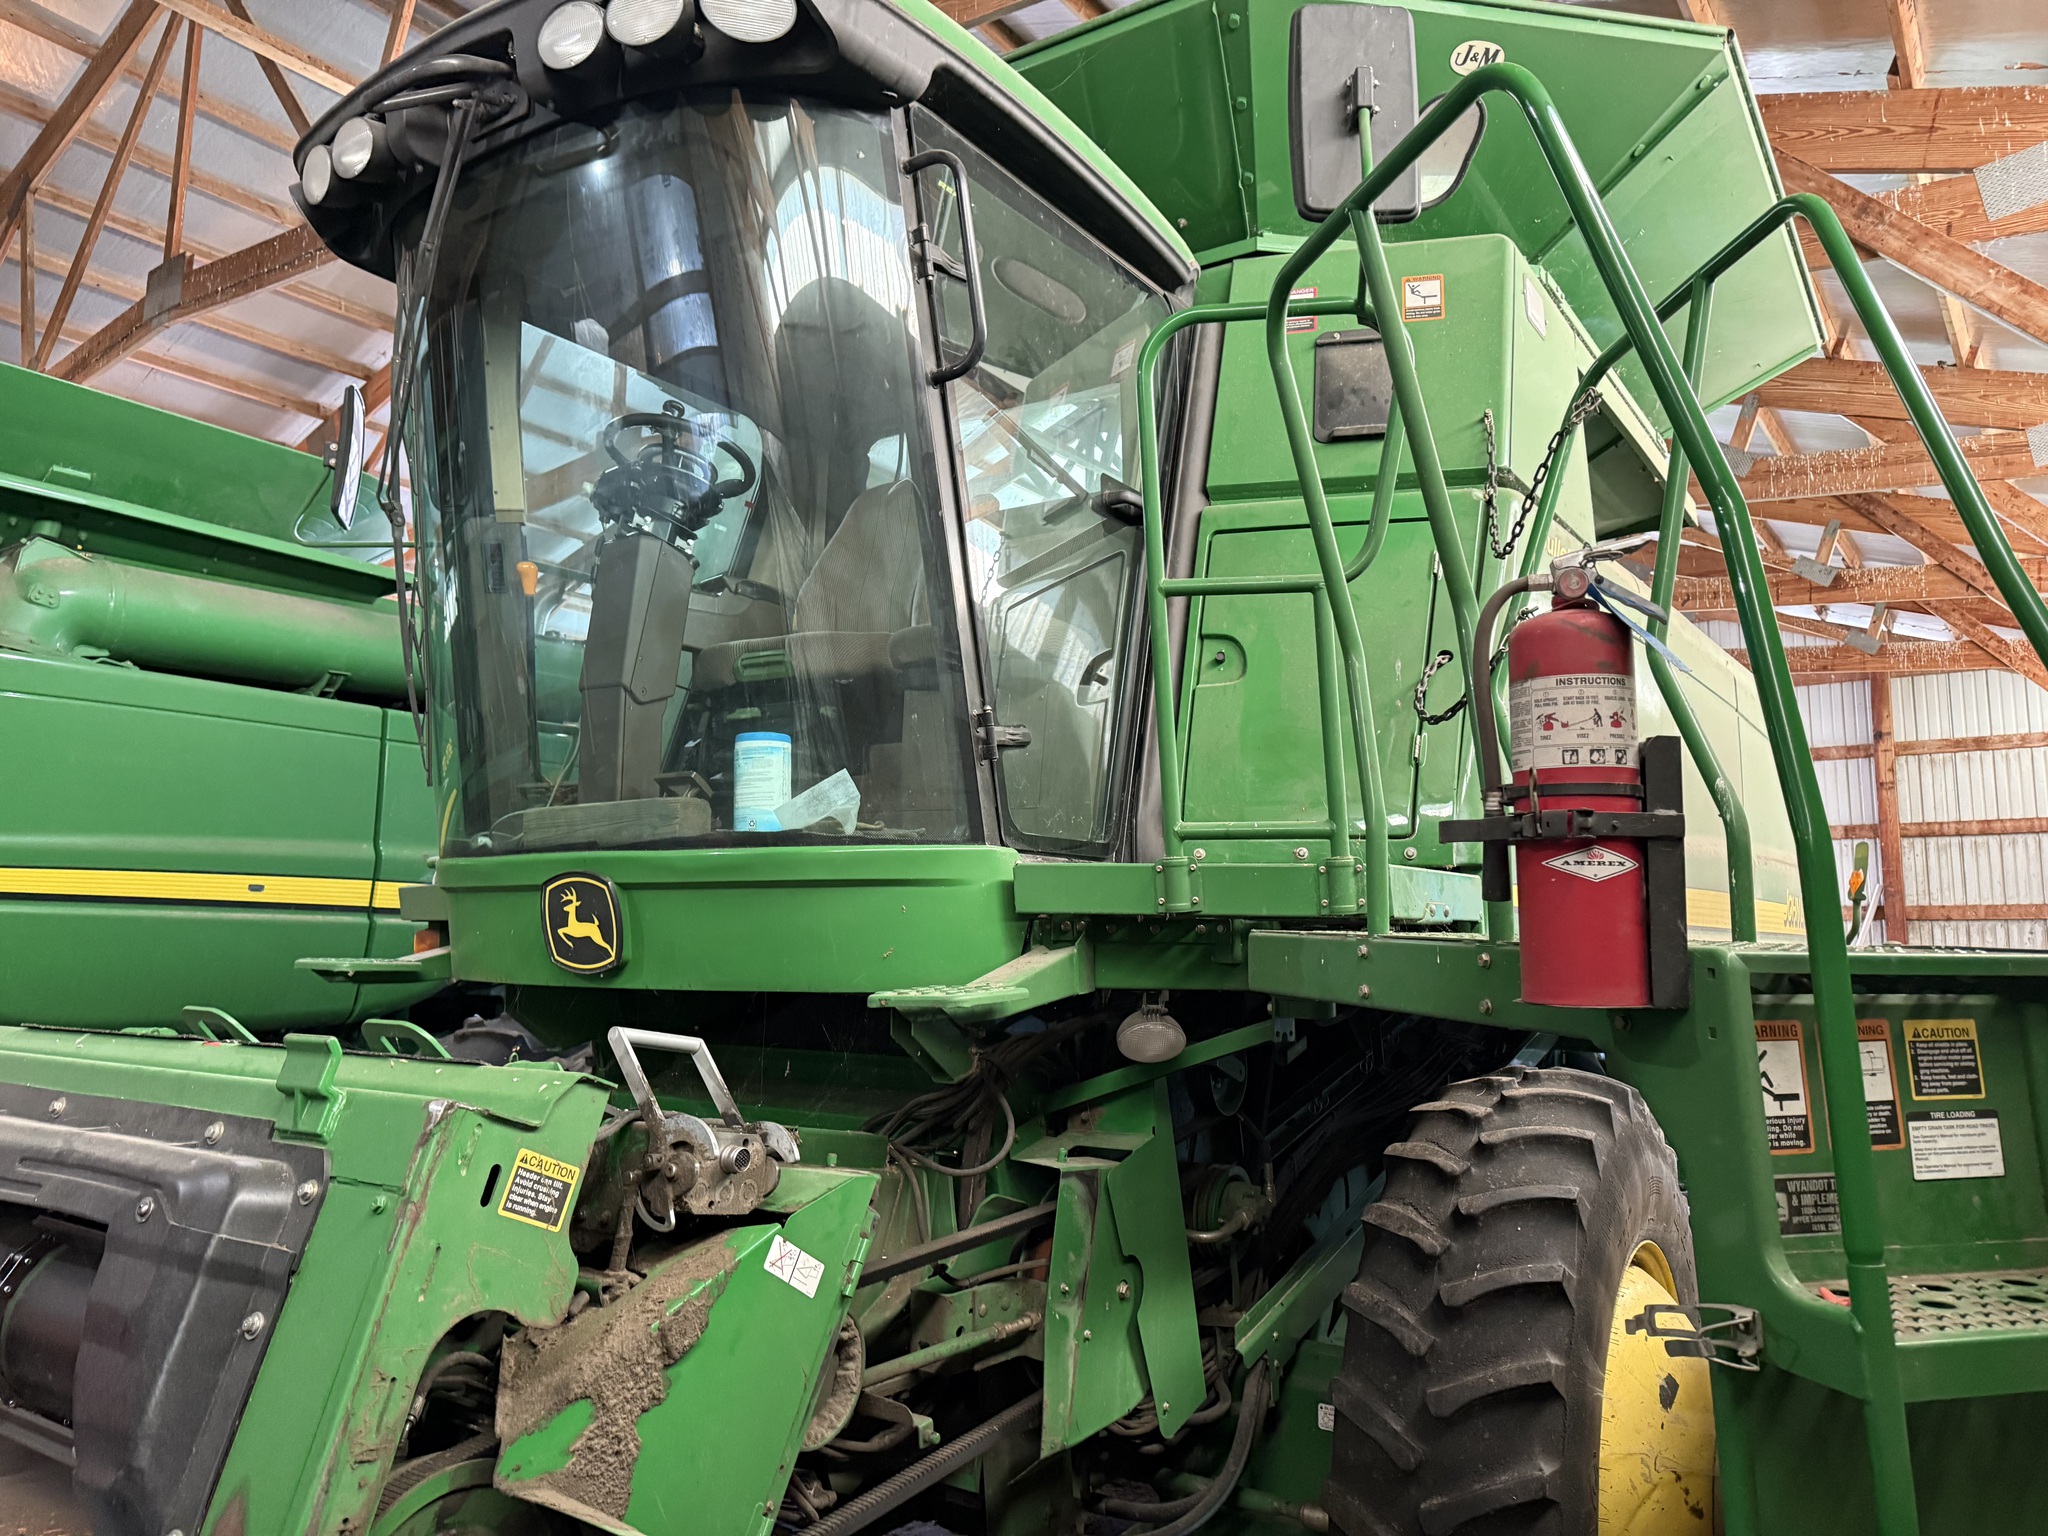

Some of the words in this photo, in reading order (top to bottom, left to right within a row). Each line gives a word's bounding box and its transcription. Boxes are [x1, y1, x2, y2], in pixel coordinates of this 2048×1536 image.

[1455, 45, 1501, 68] J&M
[1556, 677, 1626, 686] INSTRUCTIONS
[1755, 1025, 1798, 1037] ARNING
[1858, 1025, 1884, 1035] NING
[1922, 1027, 1969, 1038] CAUTION
[529, 1156, 576, 1180] CAUTION
[515, 1176, 533, 1188] Avoid
[518, 1168, 540, 1181] Header
[553, 1179, 563, 1189] tilt.
[1787, 1179, 1828, 1192] WYANDOT
[509, 1193, 523, 1203] clear
[524, 1198, 539, 1208] when
[512, 1184, 536, 1198] injuries.
[538, 1193, 552, 1204] Stay
[1792, 1195, 1798, 1206] &
[1801, 1193, 1838, 1206] IMPLEME
[506, 1200, 512, 1208] is
[512, 1204, 537, 1218] running.
